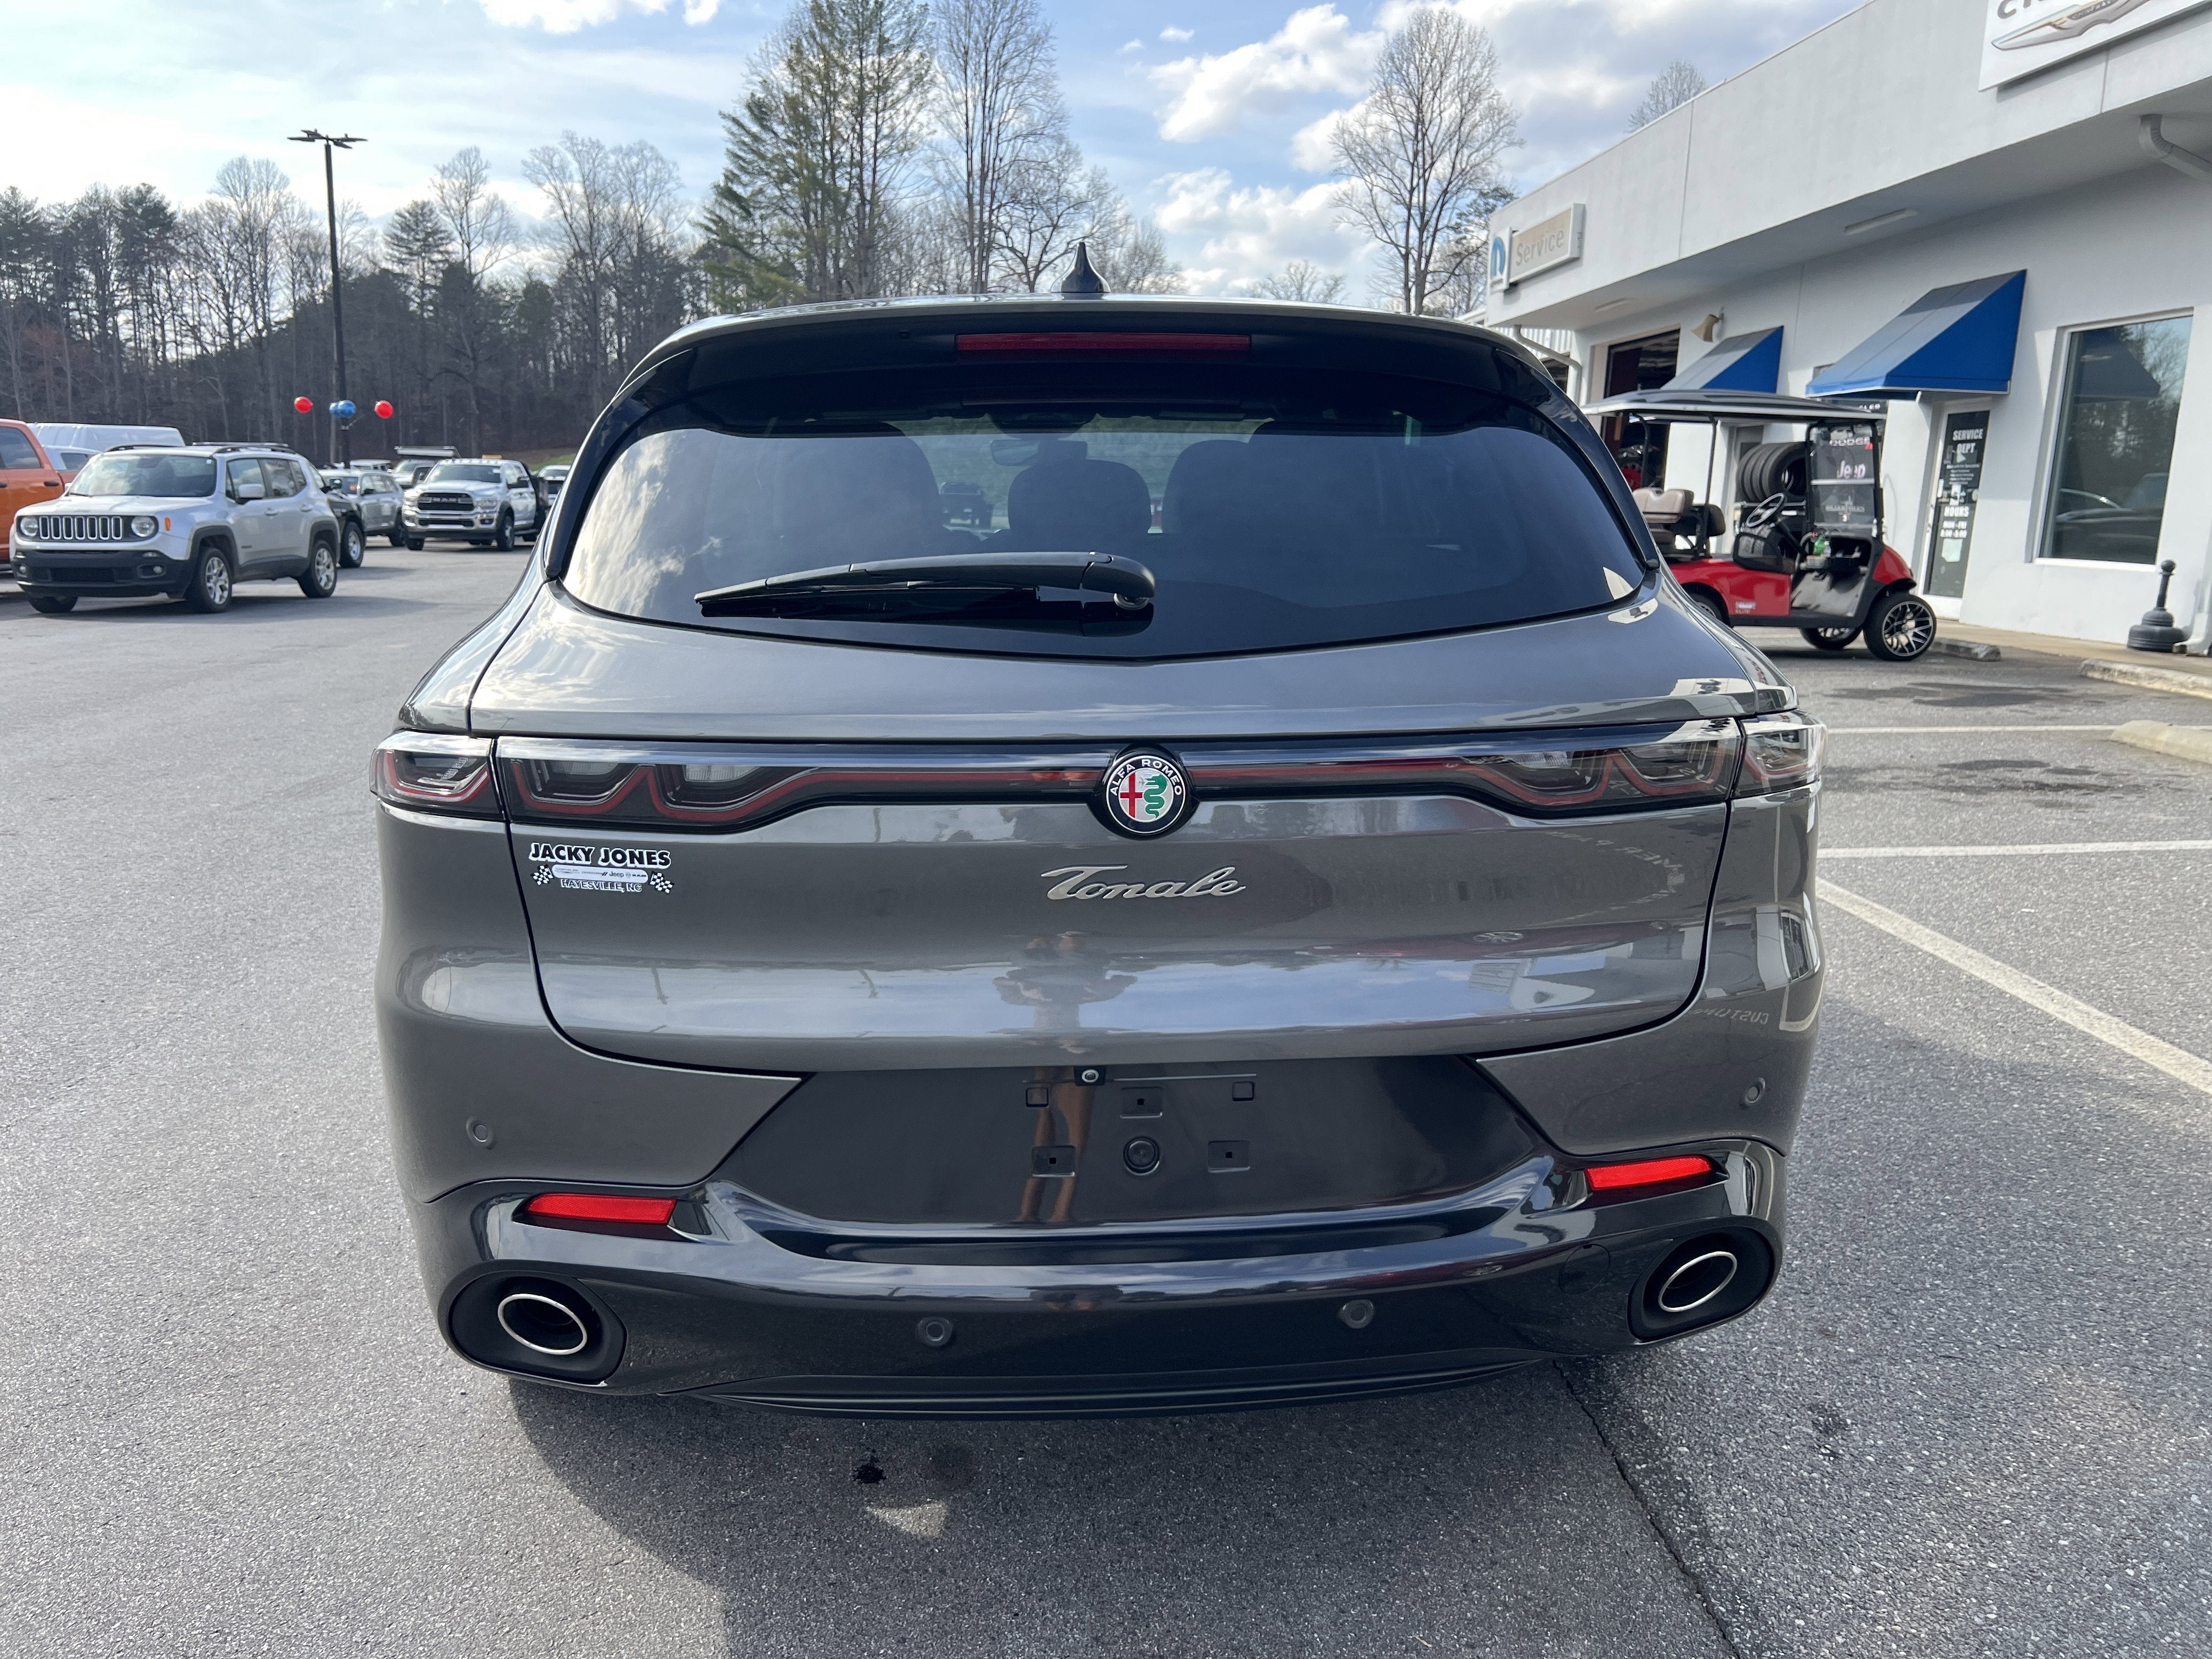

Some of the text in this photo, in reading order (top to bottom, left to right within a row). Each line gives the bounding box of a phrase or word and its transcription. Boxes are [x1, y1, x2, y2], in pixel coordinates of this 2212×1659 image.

[1516, 229, 1564, 266] Service
[1953, 428, 1984, 441] SERVICE
[1957, 442, 1976, 454] DEPT
[1944, 506, 1970, 517] HOURS
[1109, 759, 1182, 796] ALFA ROMEO
[528, 843, 672, 870] JACKY JONES
[561, 879, 642, 893] HAYESVILLE, NC
[1040, 864, 1246, 900] Tonale
